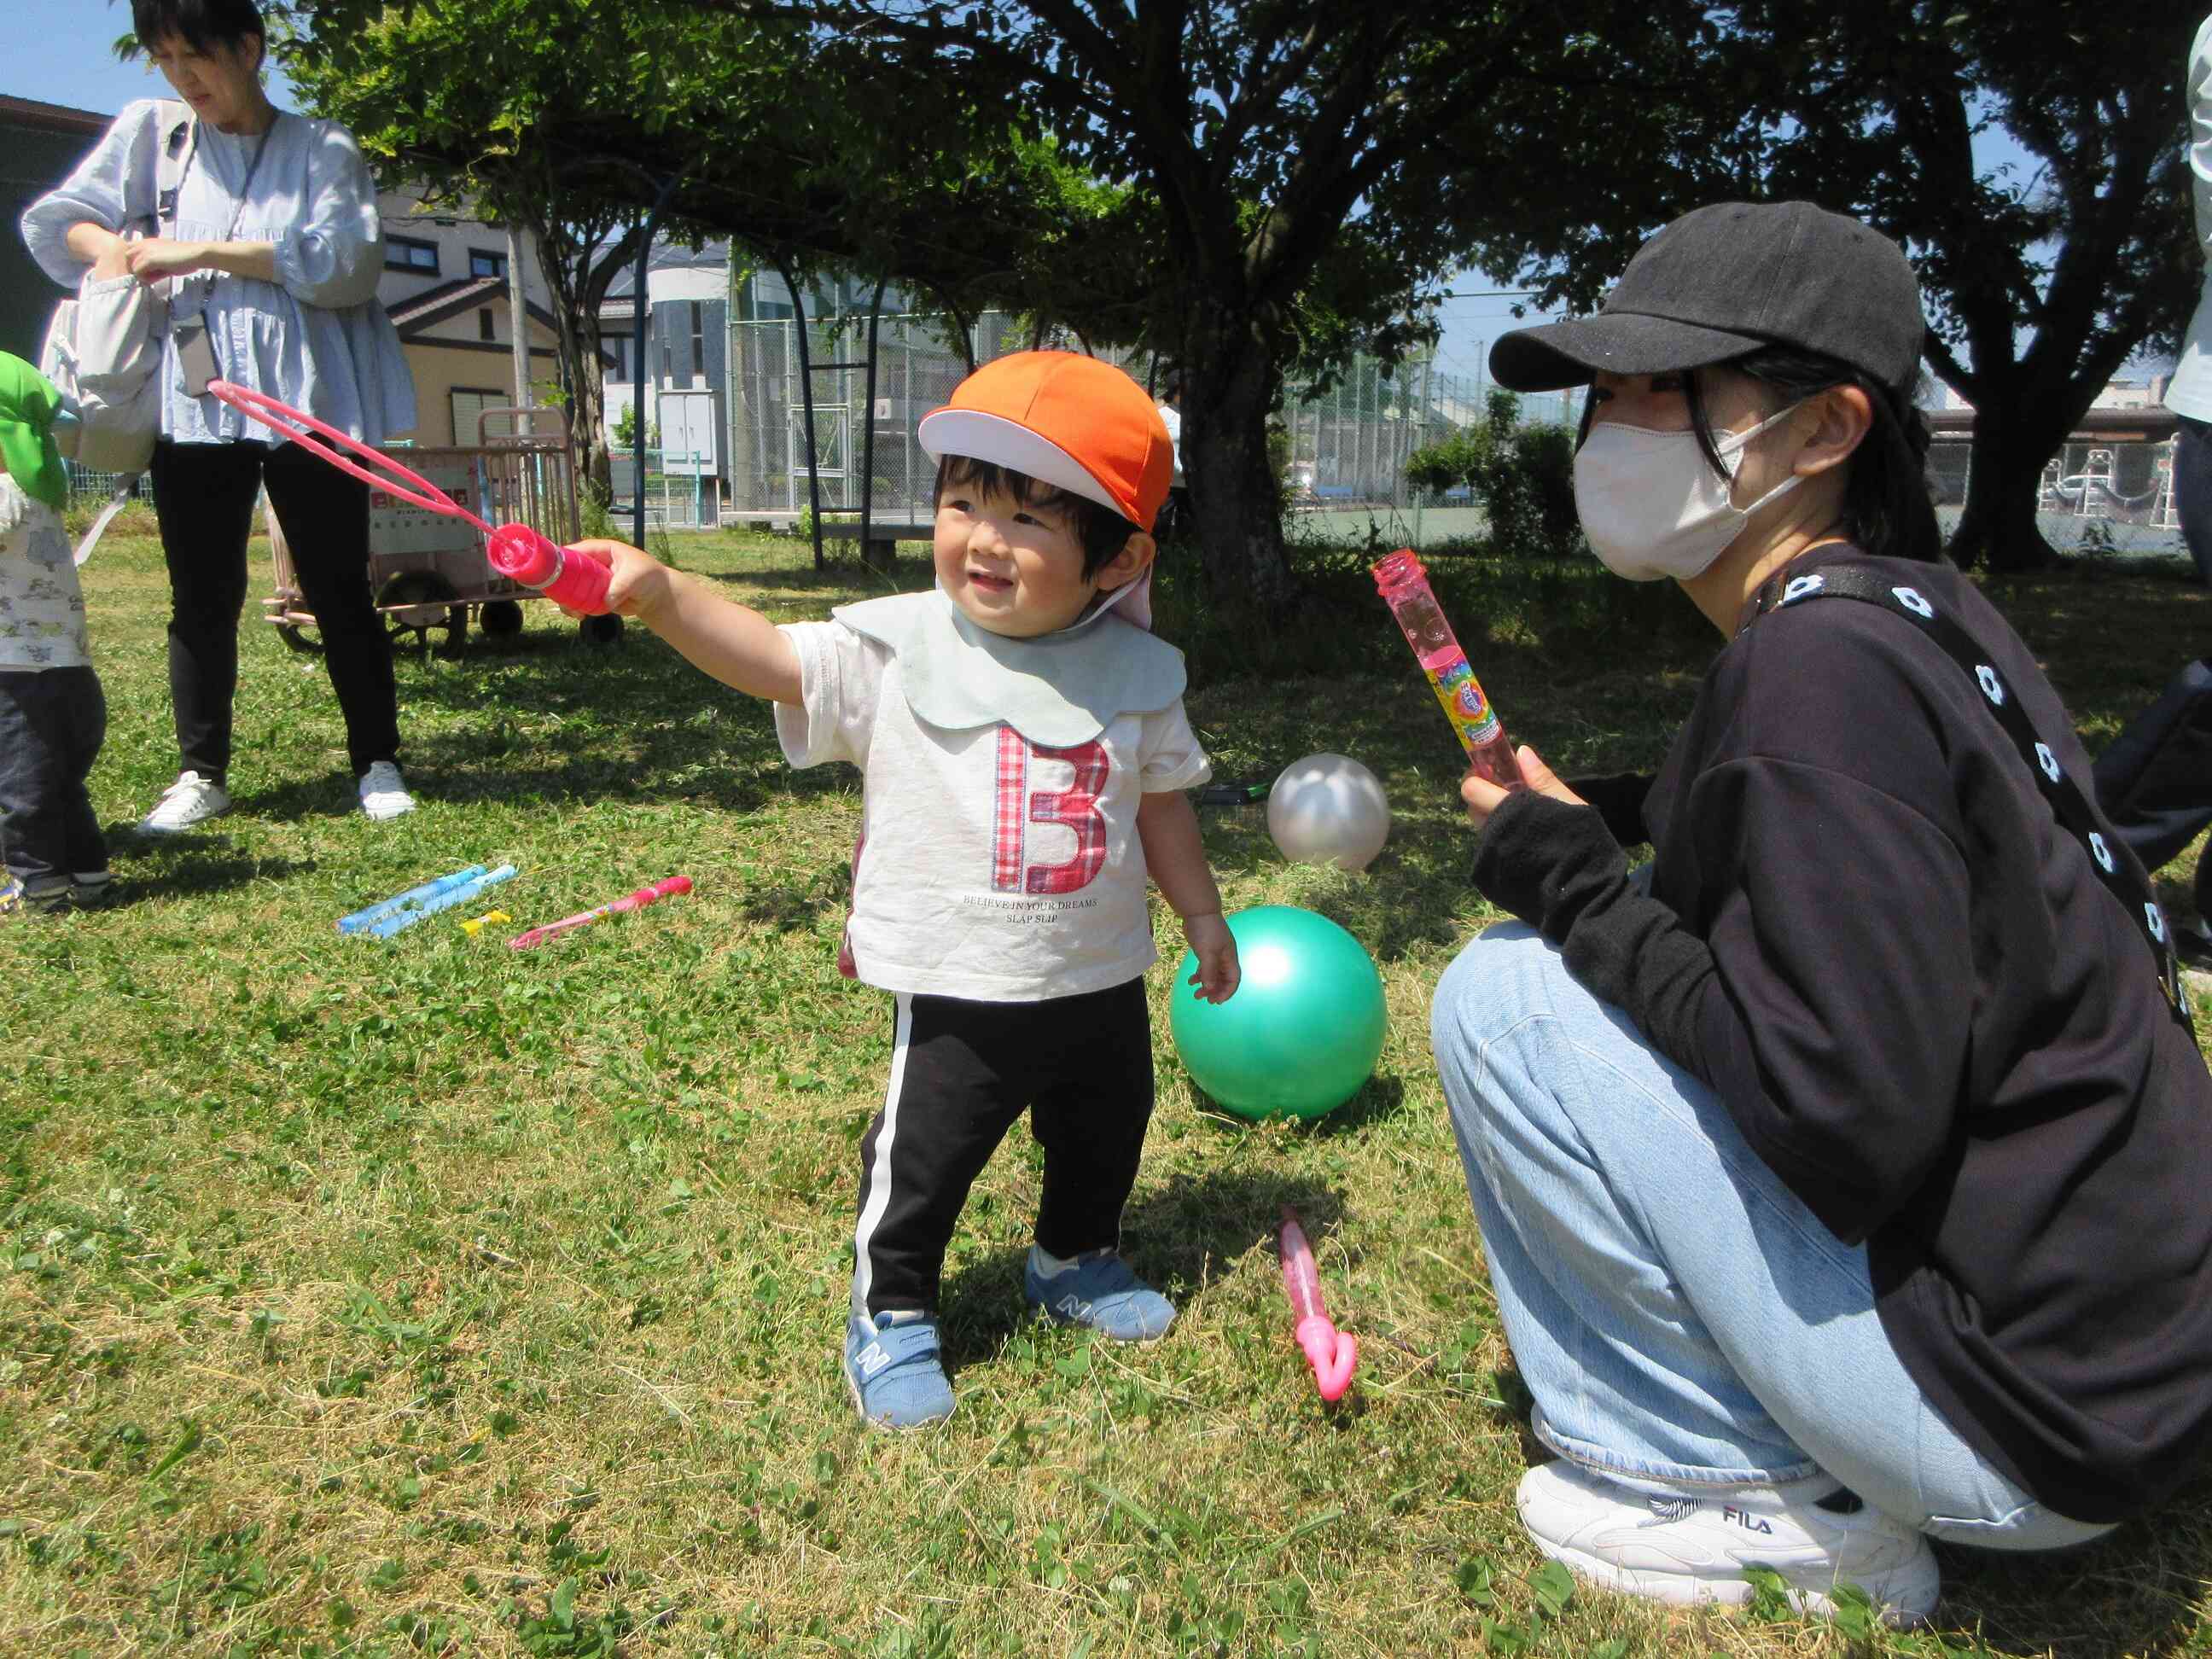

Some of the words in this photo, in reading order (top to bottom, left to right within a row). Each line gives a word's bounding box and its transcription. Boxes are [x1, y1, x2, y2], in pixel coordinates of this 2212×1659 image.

[991, 725, 1109, 894] B
[963, 894, 1010, 910] BELIEVE
[1010, 901, 1024, 911] IN
[1024, 901, 1057, 911] YOUR
[1057, 898, 1098, 911] DREAMS
[1006, 914, 1033, 923] SLAP
[1034, 913, 1058, 923] SLIP
[855, 1341, 892, 1375] N
[1723, 1505, 1773, 1534] FILA
